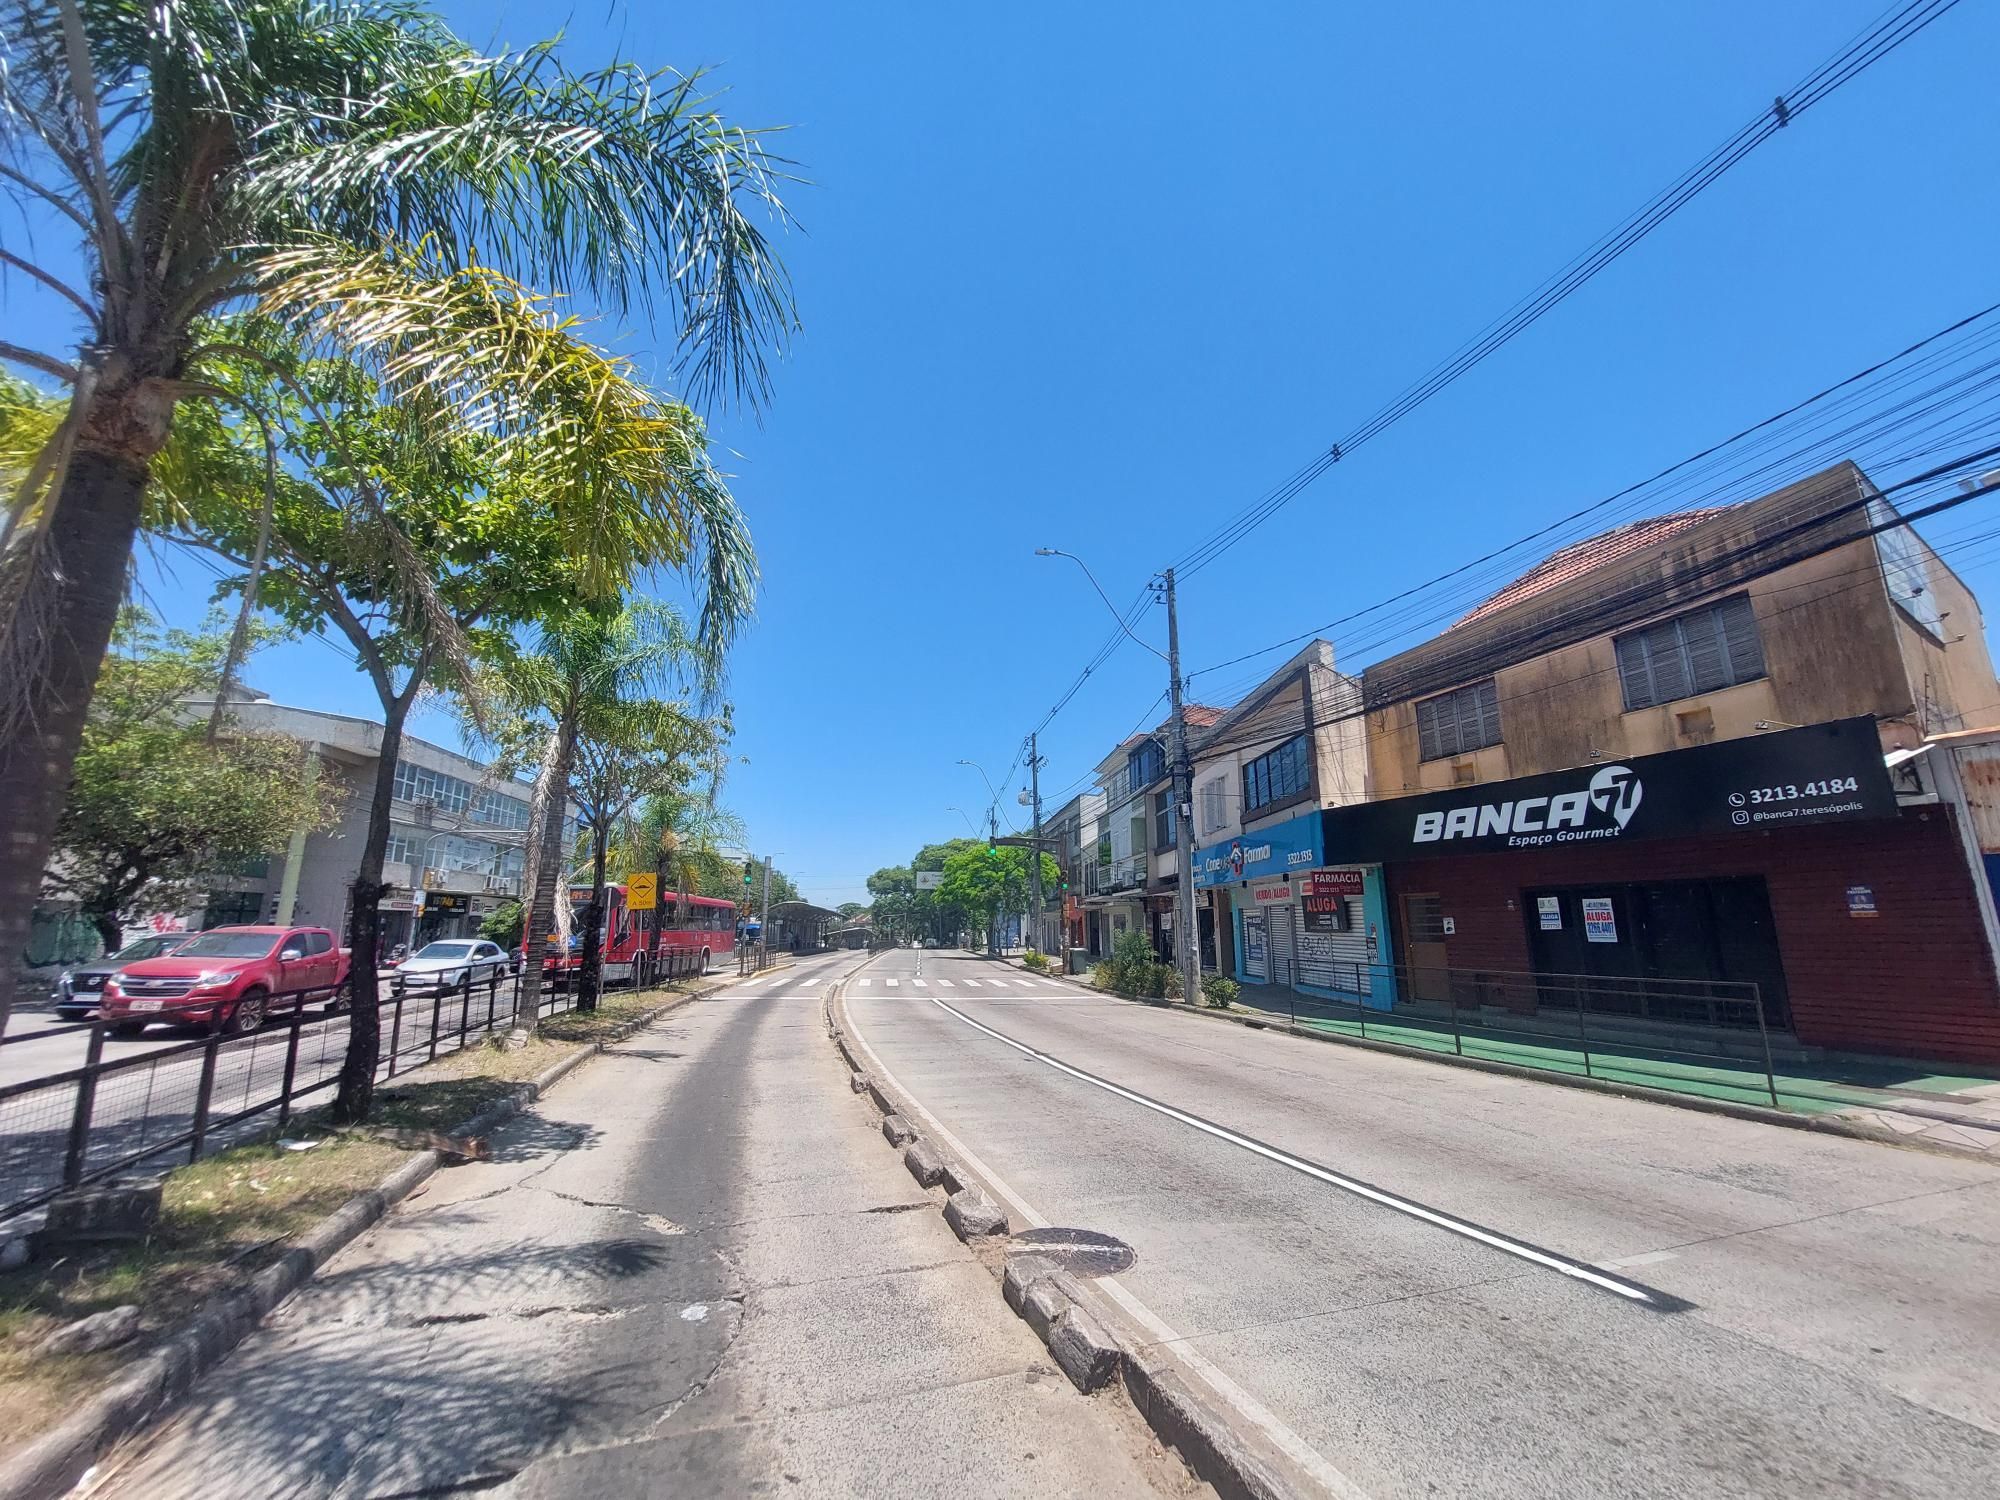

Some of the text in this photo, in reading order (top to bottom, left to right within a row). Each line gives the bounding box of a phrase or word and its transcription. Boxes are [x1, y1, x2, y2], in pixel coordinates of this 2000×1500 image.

[1750, 777, 1858, 804] 3213.4184
[1413, 790, 1590, 843] BANCA
[1753, 802, 1863, 822] @banca7.teresópolis
[1508, 825, 1621, 847] Espaço Gourmet
[1306, 897, 1338, 913] ALUGA
[1586, 911, 1612, 921] ALUGA
